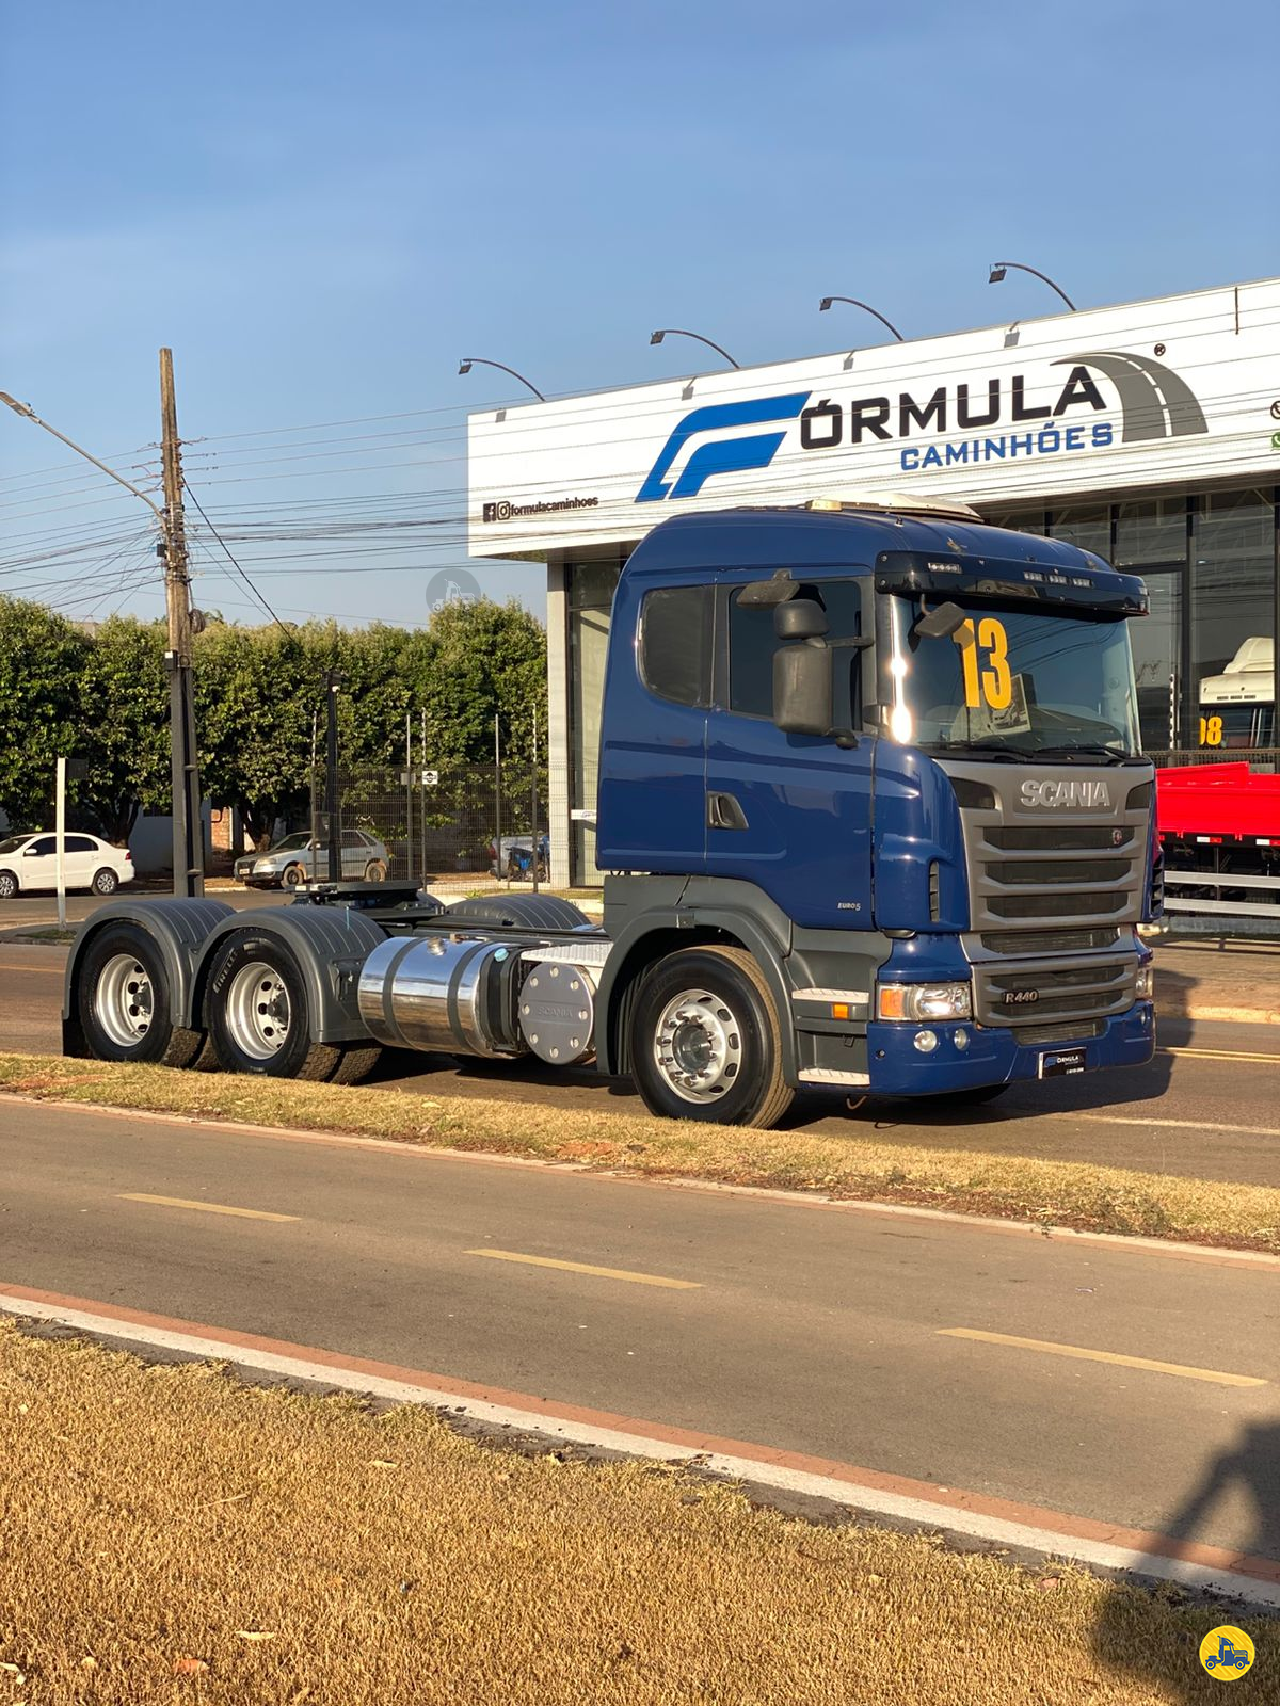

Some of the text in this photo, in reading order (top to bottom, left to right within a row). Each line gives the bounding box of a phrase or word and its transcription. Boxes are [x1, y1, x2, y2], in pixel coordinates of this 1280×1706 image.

[900, 421, 1113, 471] CAMINHÕES
[511, 497, 598, 516] formulacaminhoes
[953, 617, 1012, 710] 13
[1020, 779, 1110, 808] SCANIA
